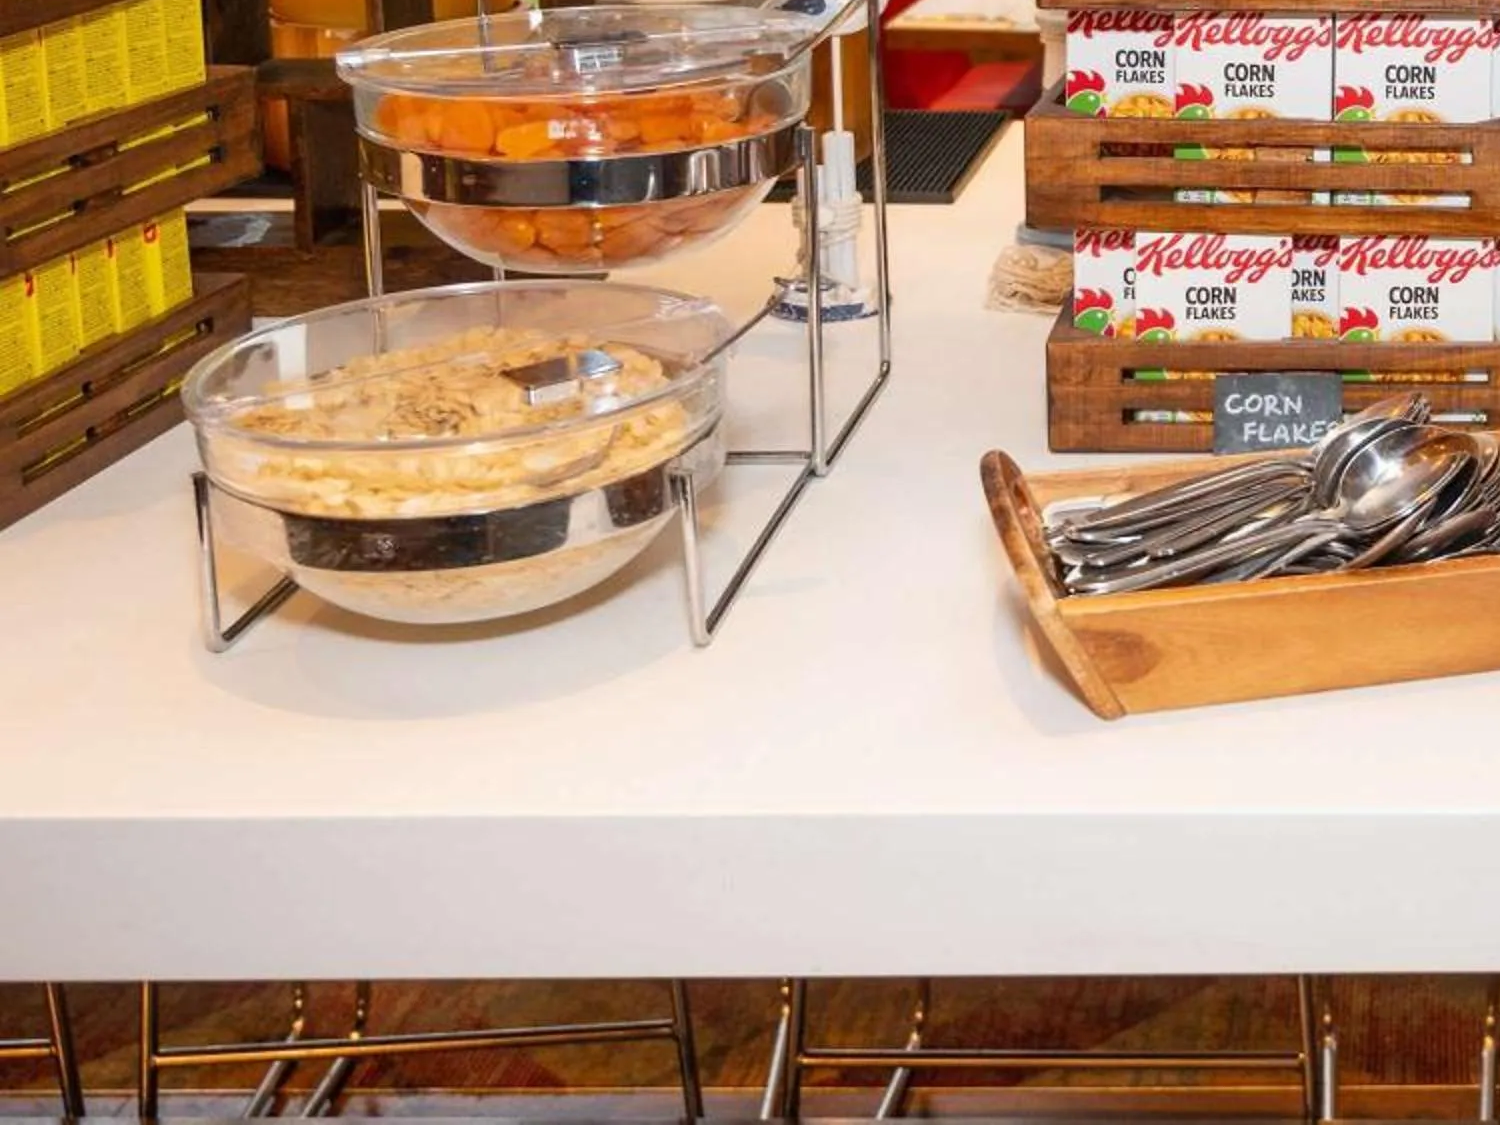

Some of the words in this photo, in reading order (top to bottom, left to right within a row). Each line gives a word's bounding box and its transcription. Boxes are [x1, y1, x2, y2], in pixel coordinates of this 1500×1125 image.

[1175, 11, 1332, 62] Kellogg's
[1336, 12, 1498, 63] Kellogg's
[1115, 49, 1166, 68] CORN
[1115, 70, 1165, 84] FLAKES
[1223, 62, 1275, 82] CORN
[1385, 64, 1437, 84] CORN
[1224, 84, 1275, 98] FLAKES
[1385, 85, 1436, 100] FLAKES
[1136, 233, 1294, 284] Kellogg's
[1339, 234, 1498, 284] Kellogg's
[1291, 268, 1326, 287] ORN
[1185, 286, 1237, 305] CORN
[1291, 288, 1326, 302] AKES
[1389, 286, 1439, 304] CORN
[1185, 306, 1237, 320] FLAKES
[1389, 305, 1439, 320] FLAKES
[1223, 392, 1304, 418] CORN
